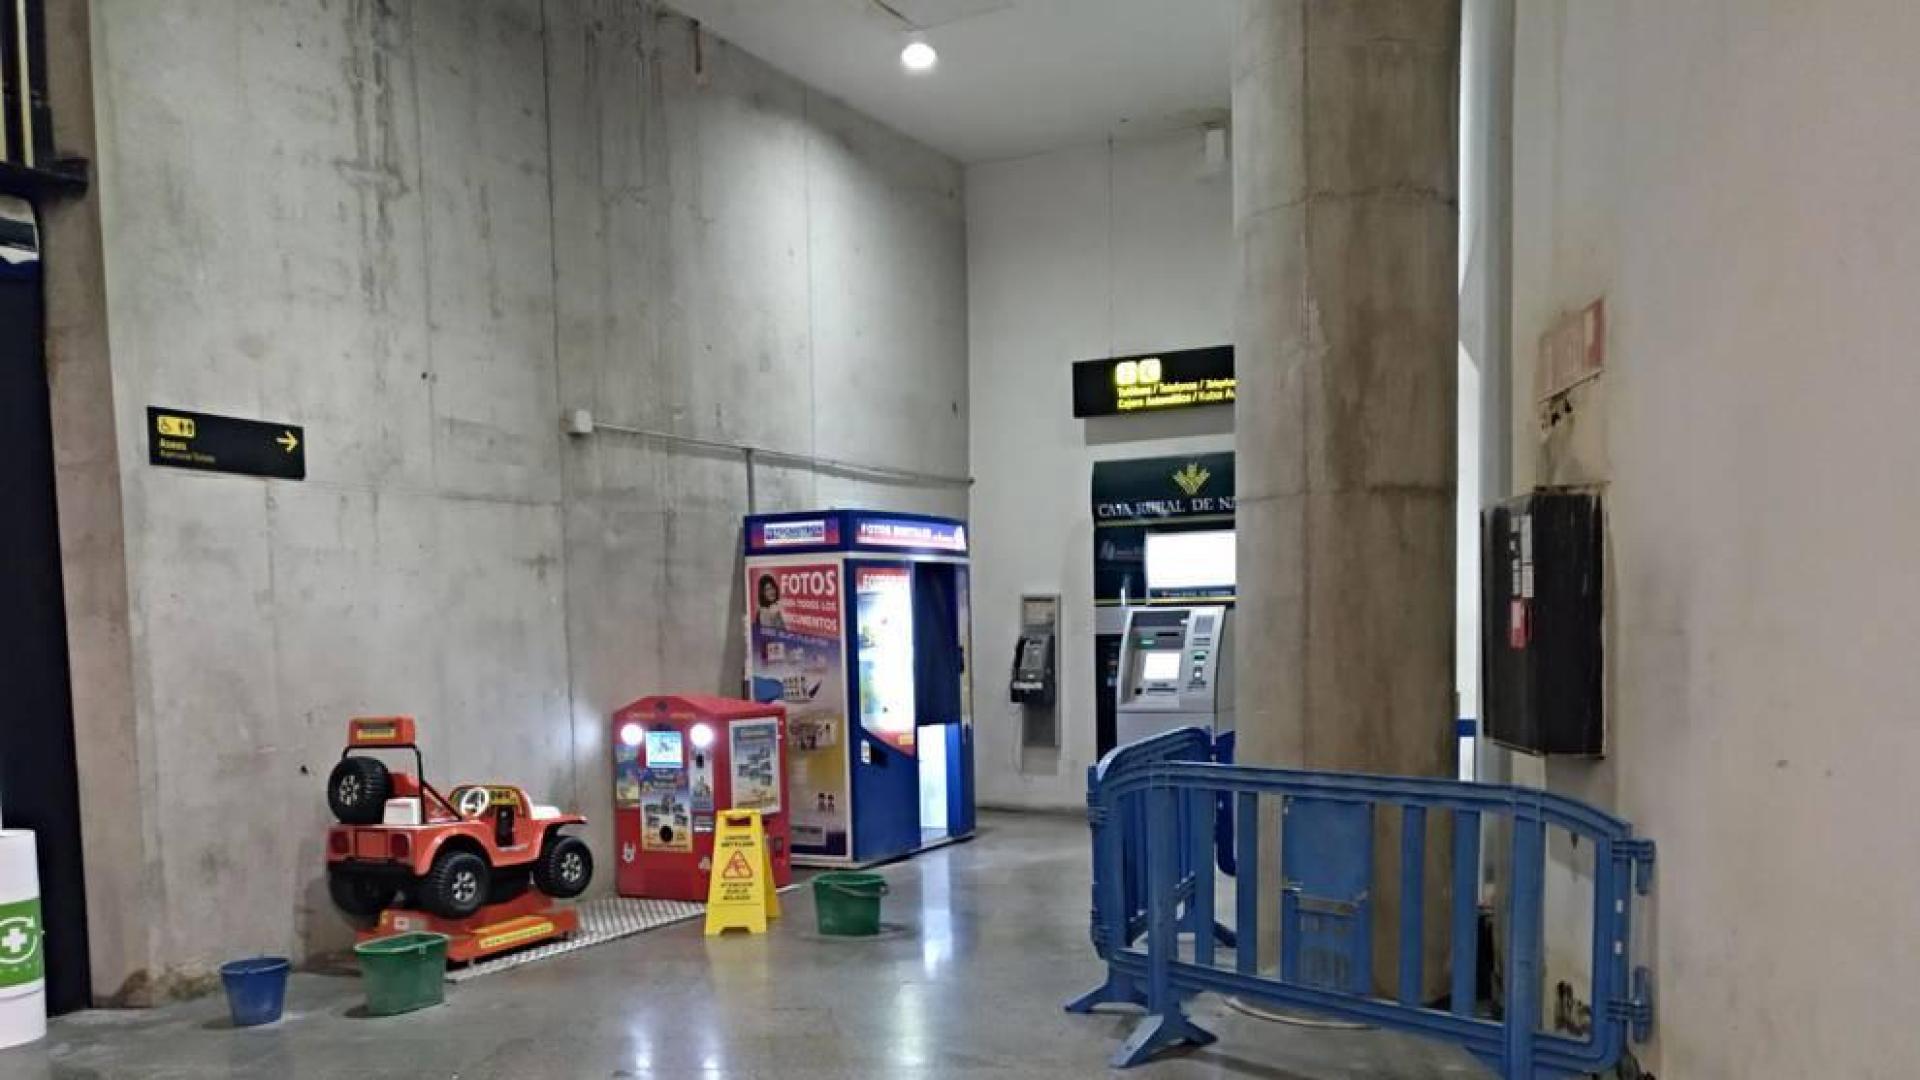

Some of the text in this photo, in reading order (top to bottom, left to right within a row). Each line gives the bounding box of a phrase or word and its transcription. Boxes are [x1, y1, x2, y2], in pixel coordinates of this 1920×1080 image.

[1098, 502, 1135, 518] CAJA
[1191, 497, 1213, 511] DE
[780, 570, 837, 596] FOTOS
